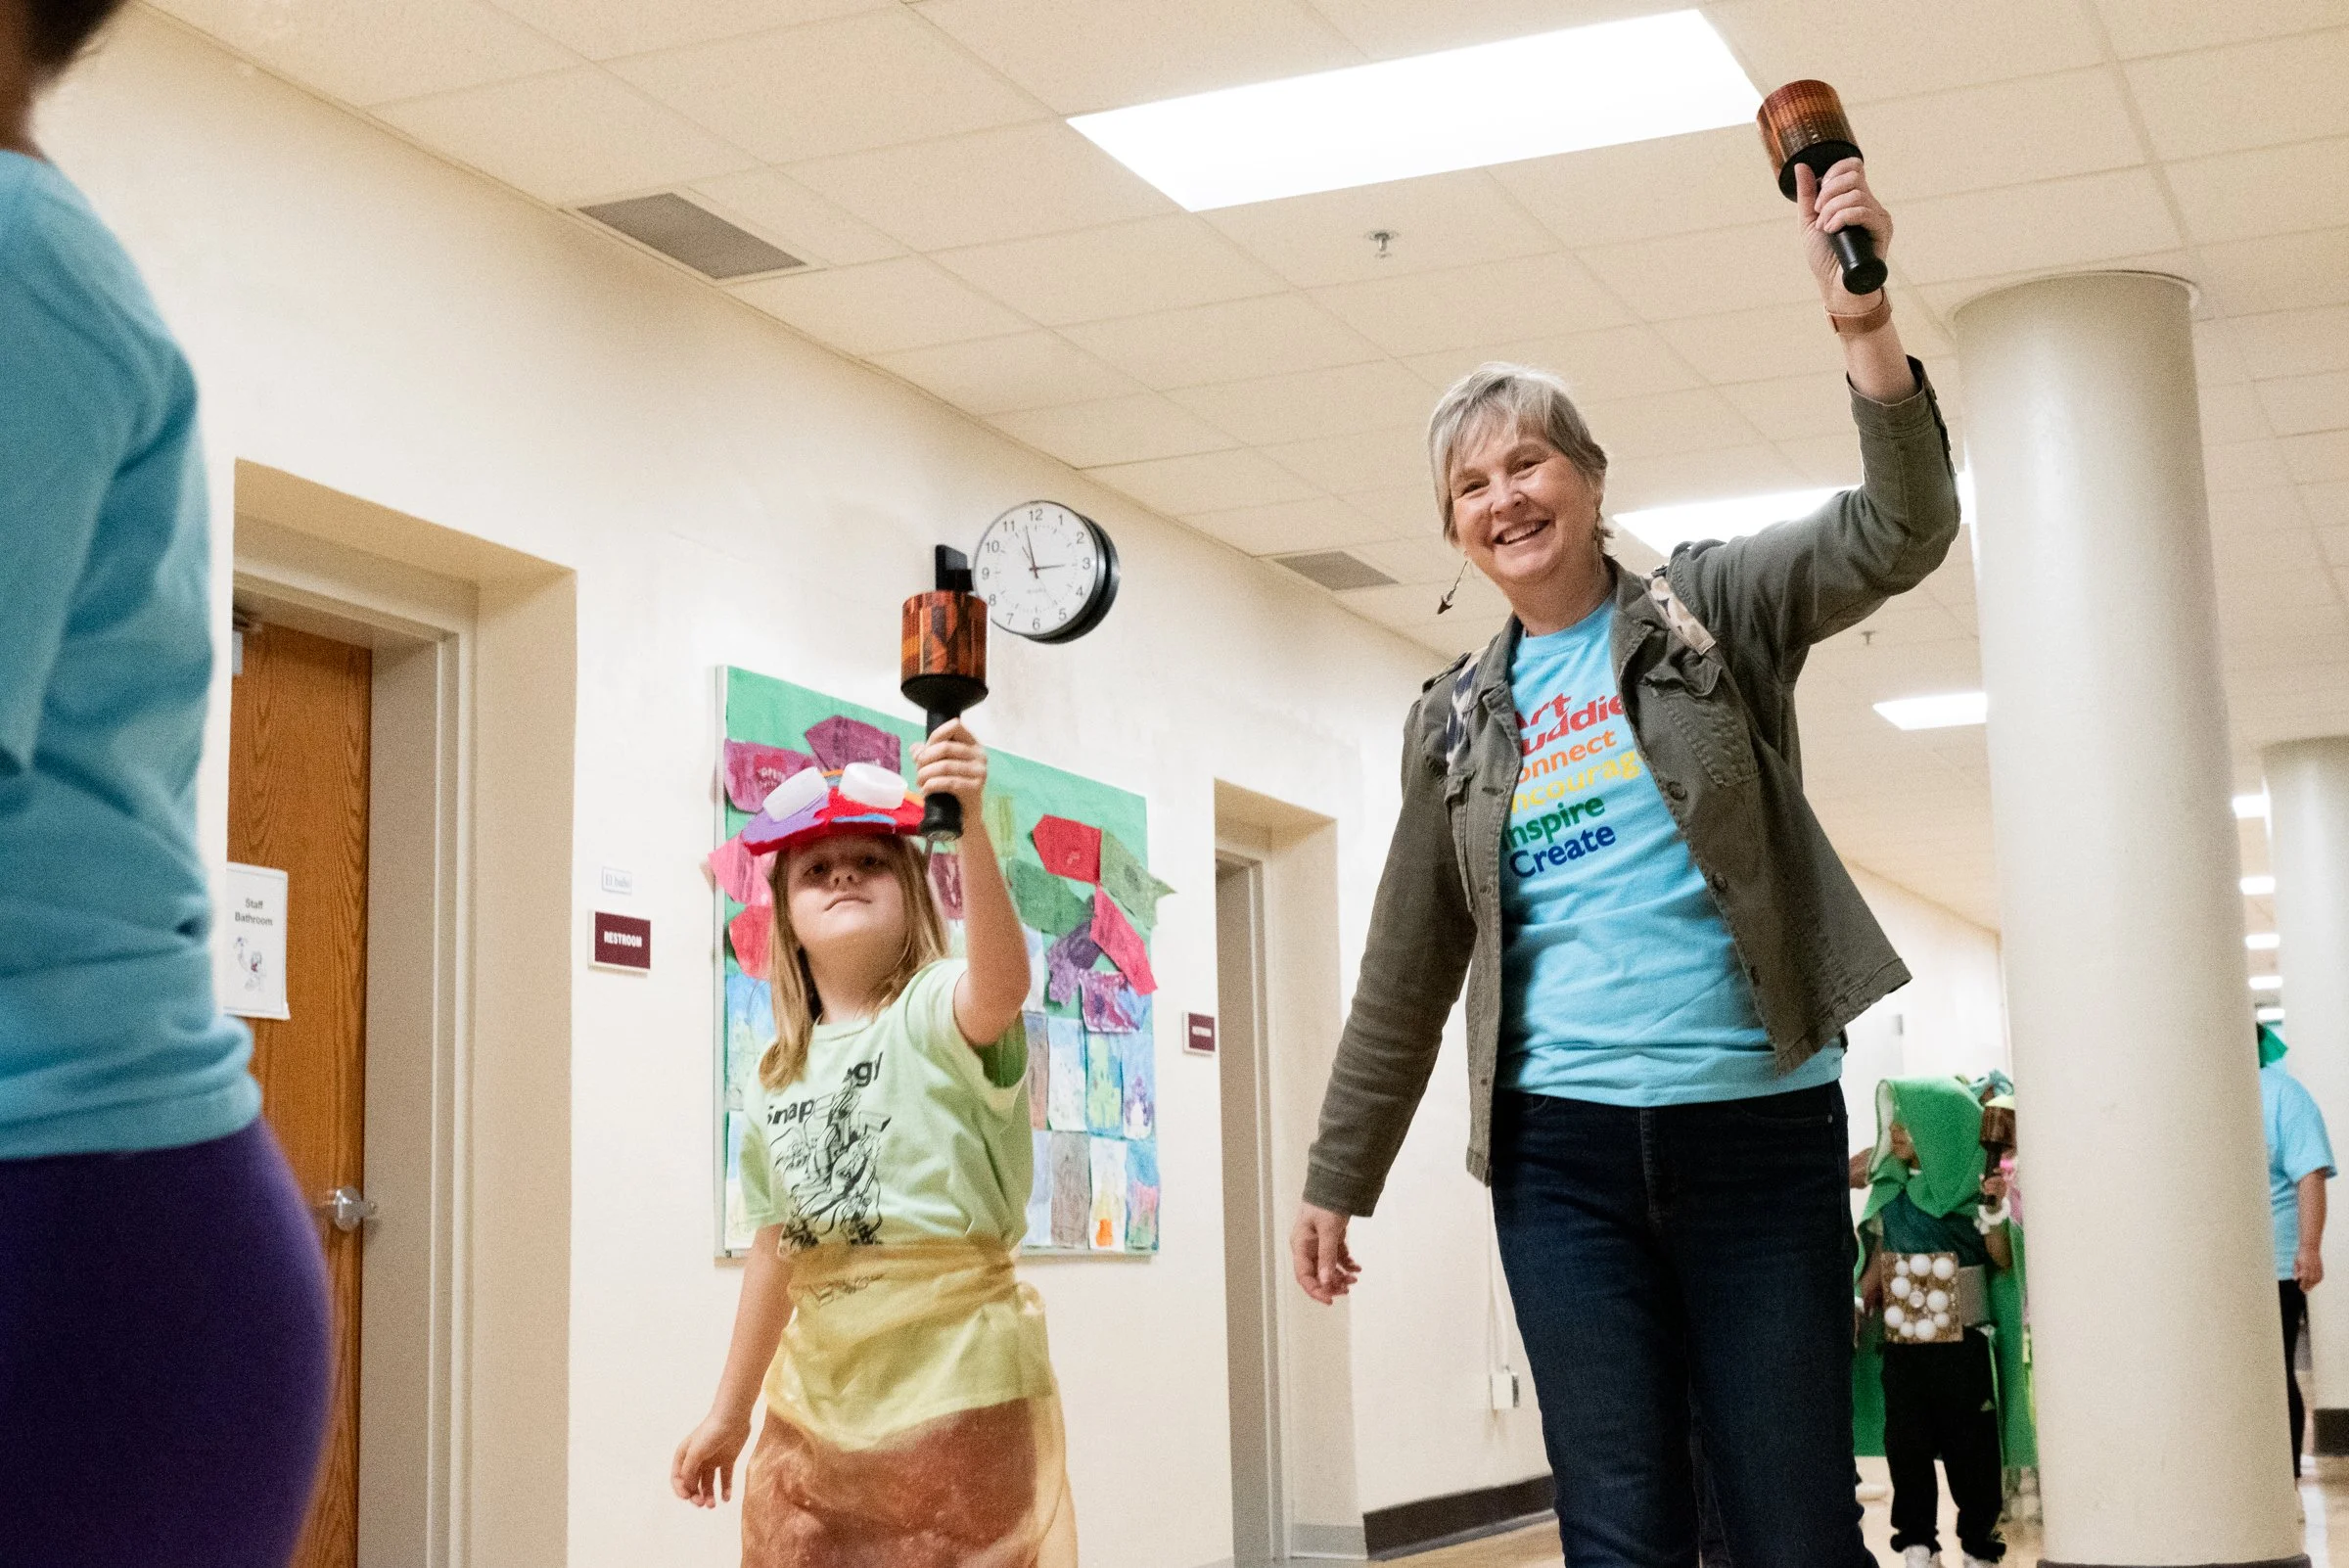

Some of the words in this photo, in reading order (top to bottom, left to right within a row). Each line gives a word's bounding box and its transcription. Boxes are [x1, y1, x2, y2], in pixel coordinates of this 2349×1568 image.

[1029, 509, 1043, 522] 12
[1058, 514, 1064, 526] 1
[1003, 520, 1015, 532] 11
[1076, 531, 1085, 544] 2
[986, 540, 999, 553] 10
[1082, 557, 1091, 570] 3
[982, 568, 990, 580] 9
[1076, 586, 1083, 597] 4
[989, 594, 996, 606] 8
[1006, 613, 1014, 625] 7
[1058, 608, 1067, 622] 5
[1032, 619, 1040, 630] 6
[1517, 729, 1617, 784] onnect
[1508, 825, 1617, 878] Create
[245, 898, 264, 910] Staff
[234, 911, 274, 927] Bathroom
[603, 930, 643, 948] RESTROOM
